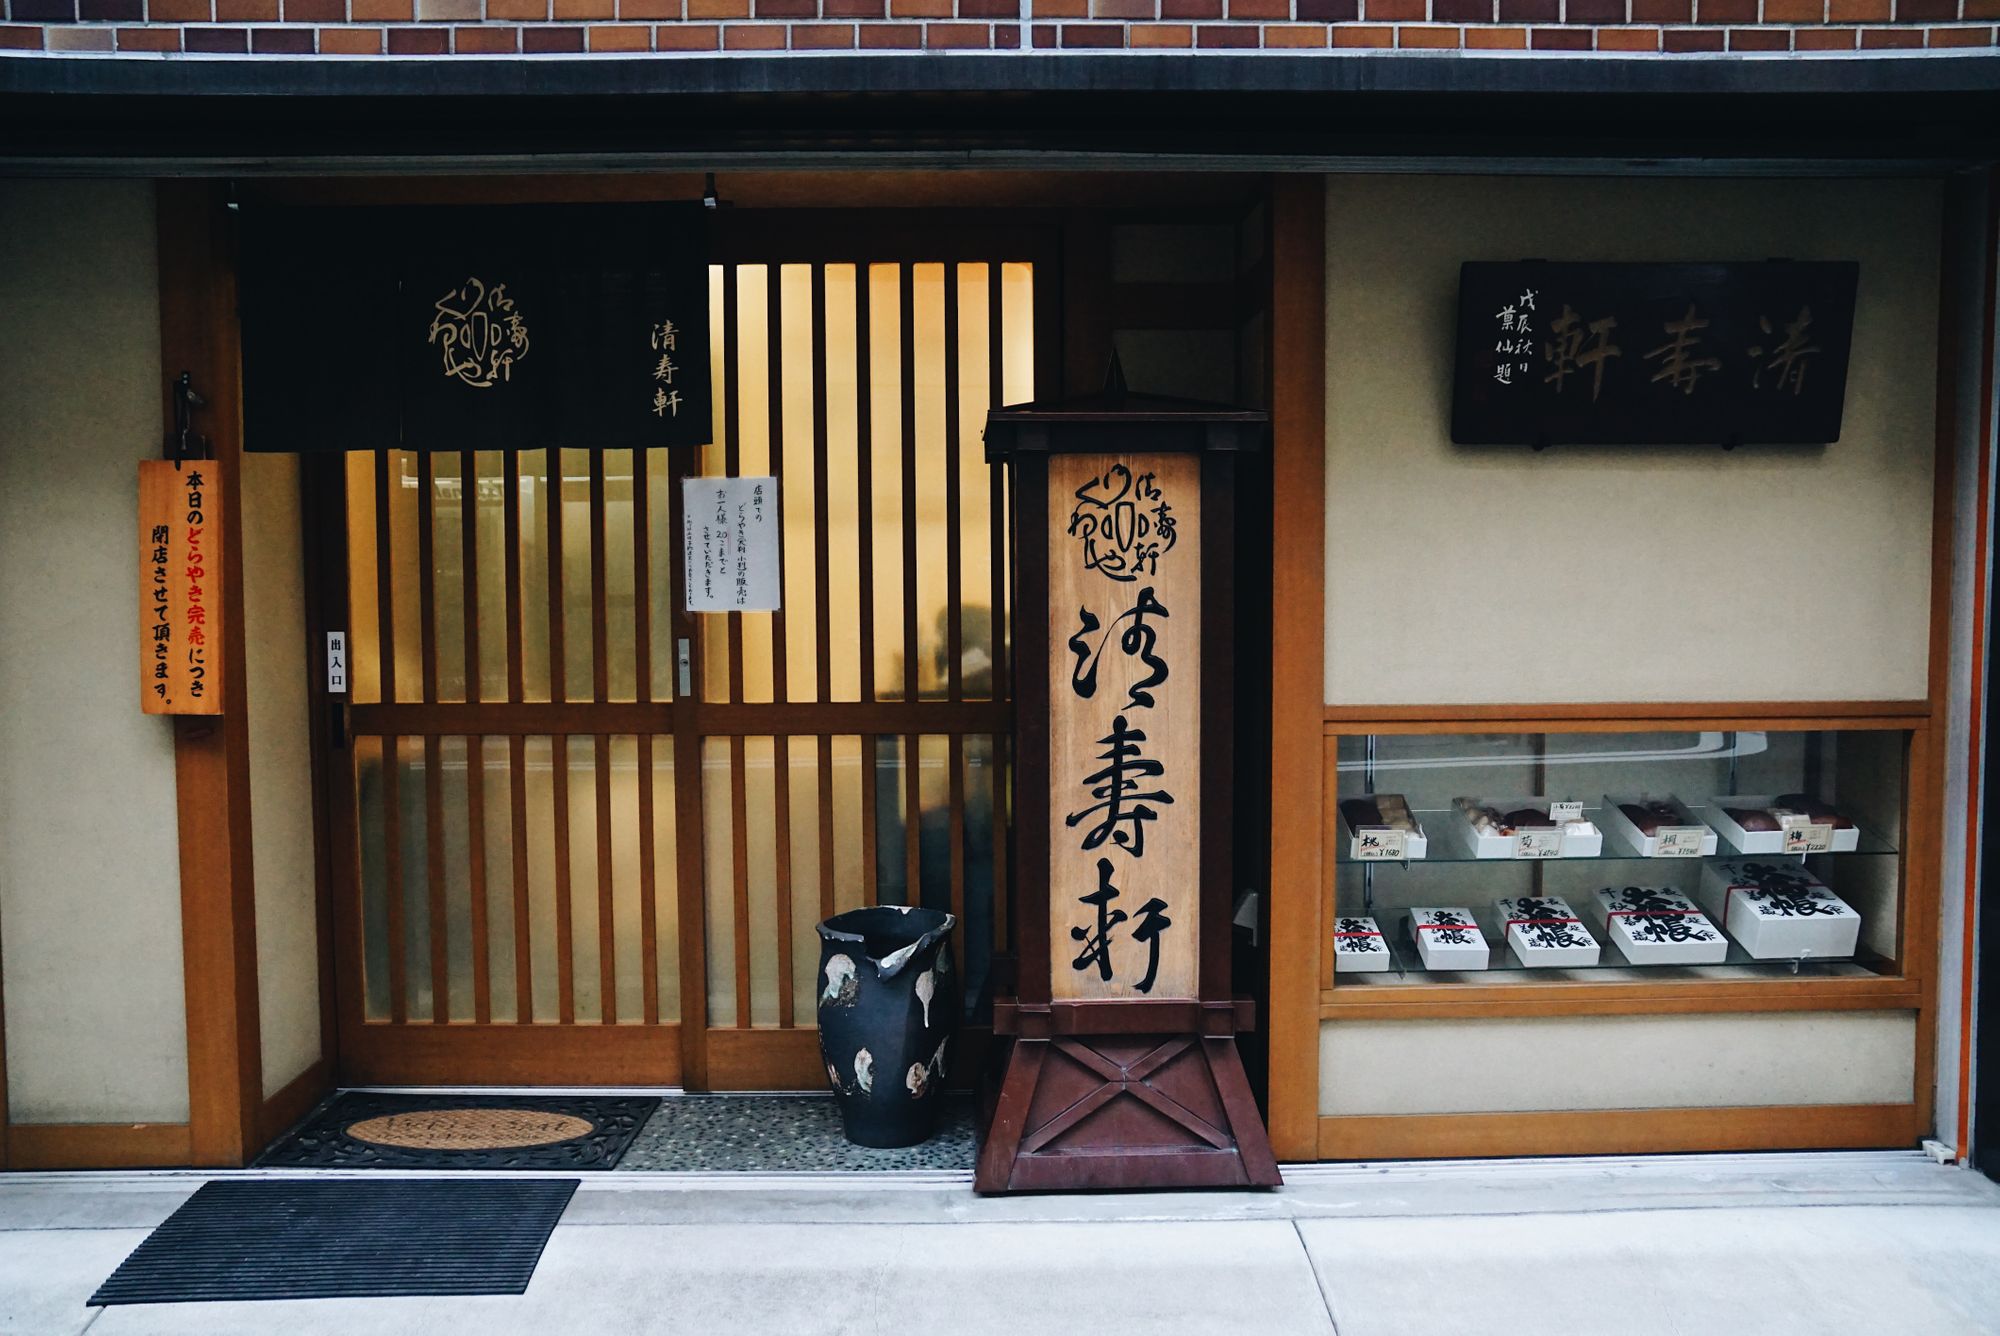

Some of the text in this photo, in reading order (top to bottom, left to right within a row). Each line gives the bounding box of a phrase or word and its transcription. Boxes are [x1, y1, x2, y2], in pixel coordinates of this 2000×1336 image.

[651, 319, 683, 417] 清寿軒
[151, 525, 172, 705] 閉店させて頂きます。
[185, 470, 206, 698] 本日のどらやき完売につき
[331, 639, 343, 686] 出入口
